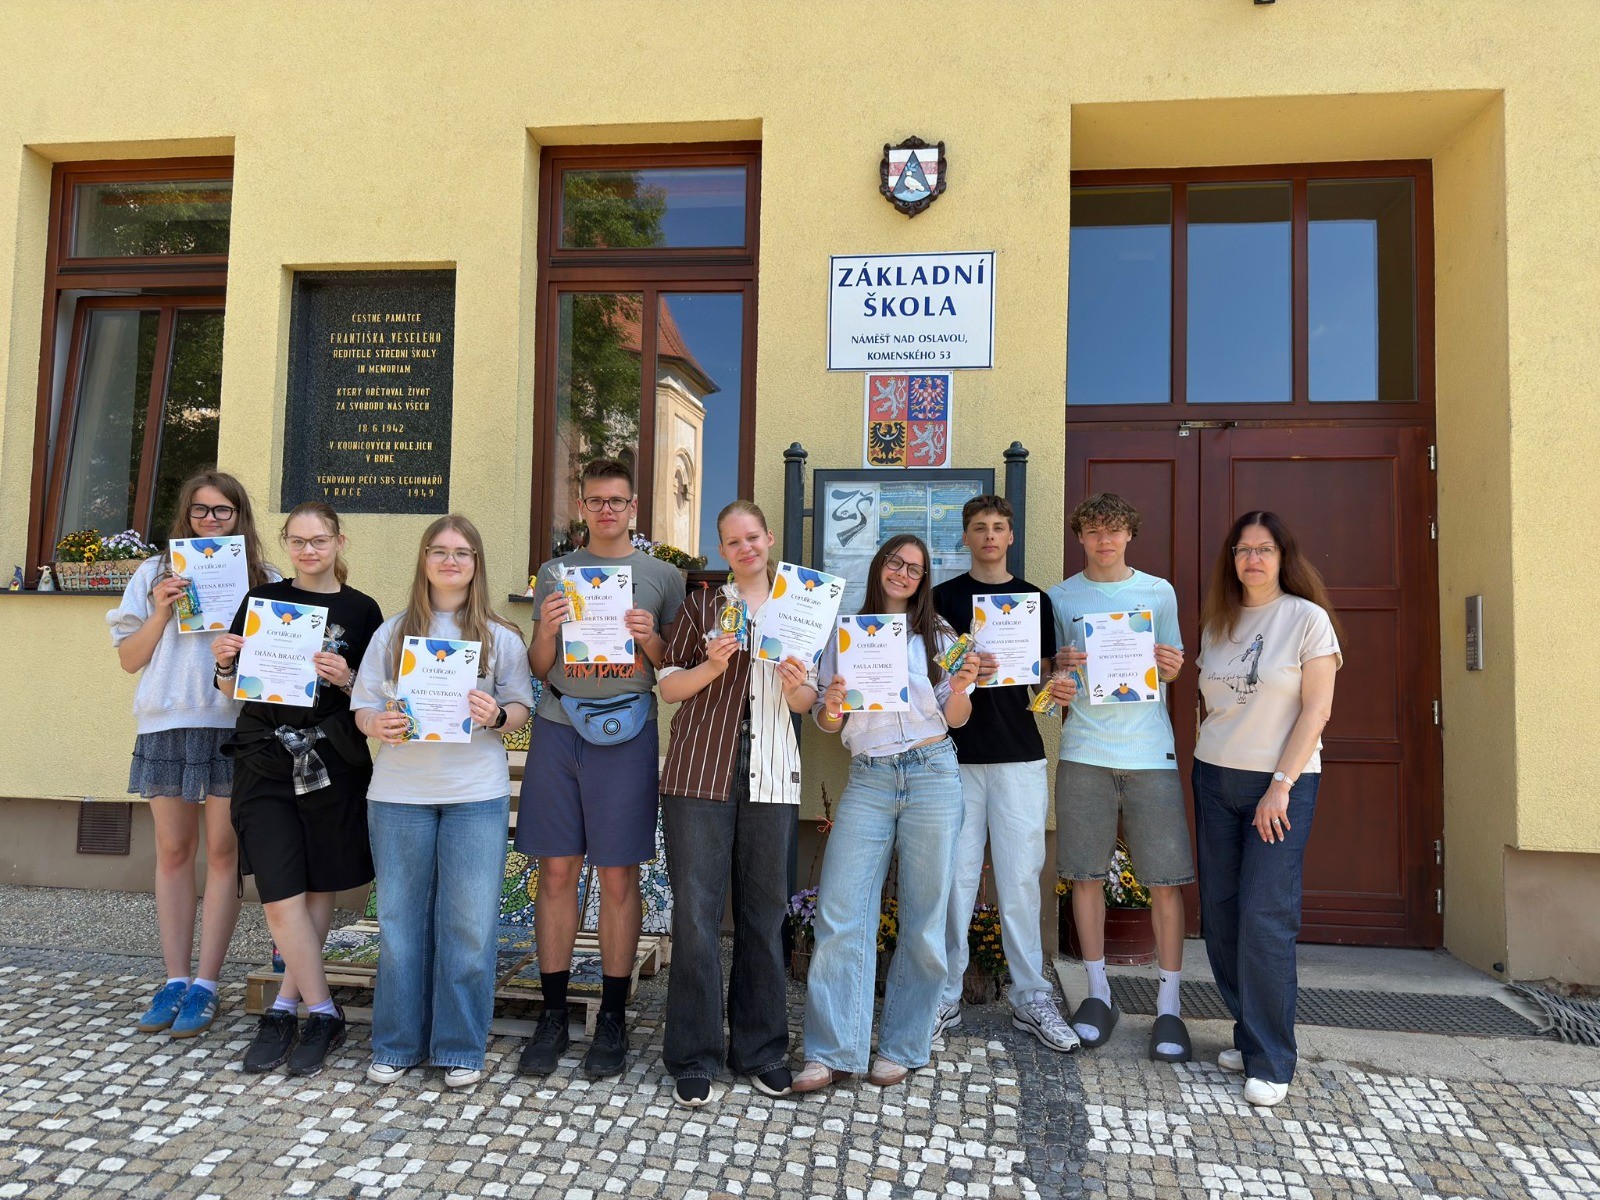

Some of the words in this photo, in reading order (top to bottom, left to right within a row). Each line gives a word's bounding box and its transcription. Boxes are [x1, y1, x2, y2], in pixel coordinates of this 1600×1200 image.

[838, 259, 985, 287] ZÁKLADNÍ
[864, 292, 957, 317] ŠKOLA
[330, 331, 384, 344] FRANTIŠKA
[392, 331, 441, 343] VESELÉHO
[851, 333, 890, 344] NÁMĚŠŤ
[893, 335, 915, 343] NAD
[918, 334, 968, 343] OSLAVOU,
[333, 348, 371, 358] ŘEDITELE
[375, 347, 408, 358] STŘEDNÍ
[412, 348, 436, 358] ŠKOLY
[867, 350, 936, 361] KOMENSKÉHO
[940, 351, 951, 360] 53
[358, 365, 365, 373] IN
[369, 365, 410, 373] MEMORIAM
[366, 386, 404, 396] OBĚTOVAL
[407, 386, 430, 396] ŽIVOT
[336, 402, 345, 410] ZA
[350, 402, 384, 410] SVOBODU
[406, 401, 430, 410] VŠECH
[330, 442, 334, 450] V
[338, 440, 391, 450] KOUNICOVÝCH
[394, 440, 433, 450] KOLEJÍCH
[380, 476, 395, 484] SBS
[324, 488, 330, 496] V
[334, 488, 362, 496] ROCE
[408, 488, 435, 497] 1949
[790, 593, 822, 606] Certificate
[267, 629, 302, 638] Certificate
[422, 667, 457, 675] Certificate
